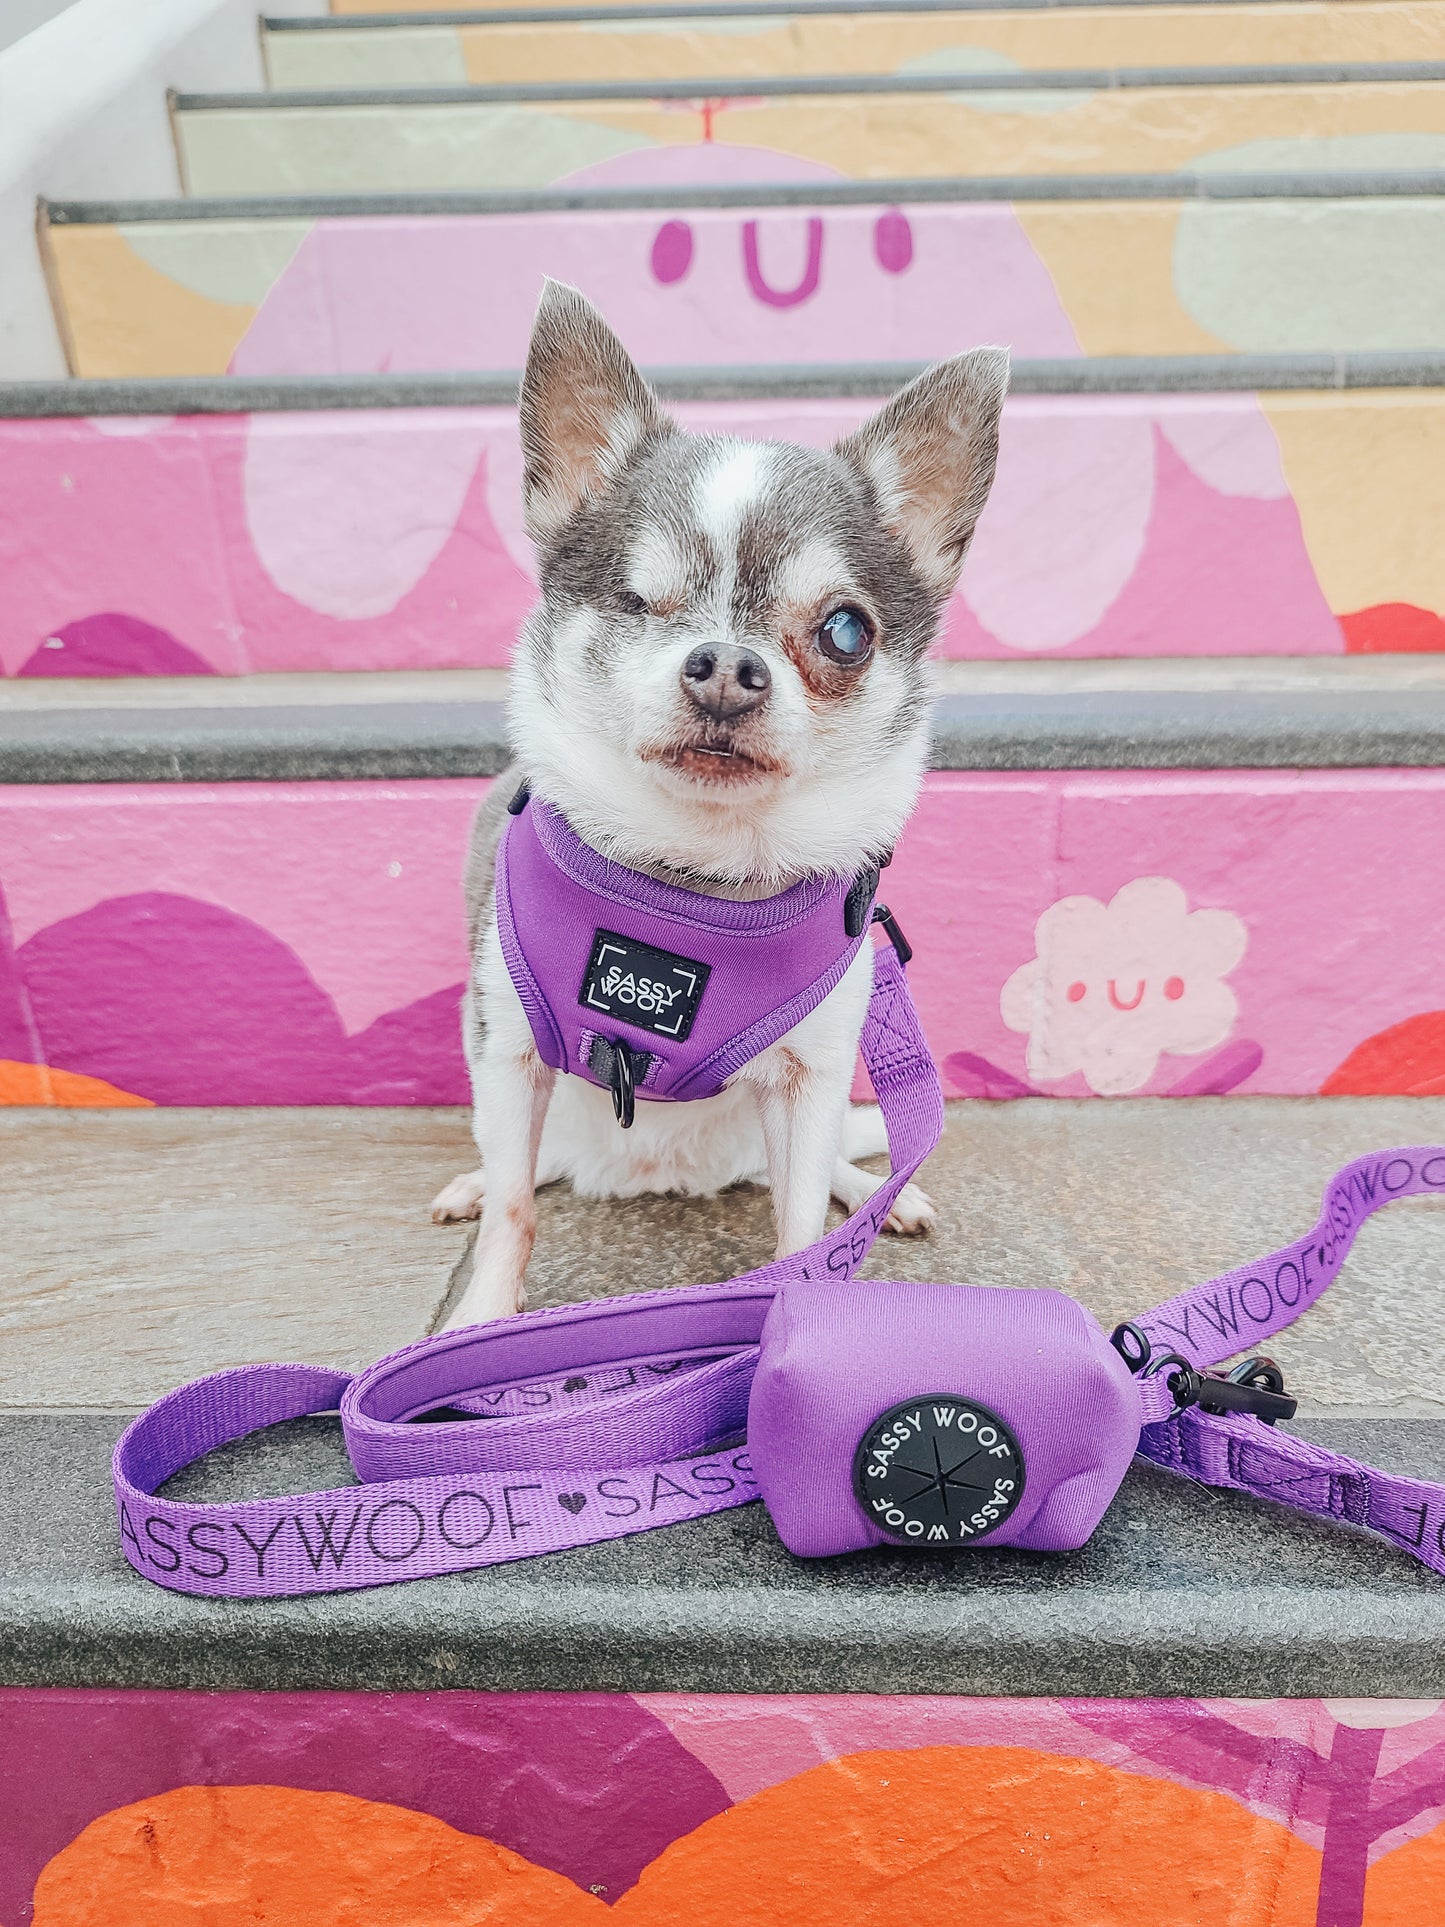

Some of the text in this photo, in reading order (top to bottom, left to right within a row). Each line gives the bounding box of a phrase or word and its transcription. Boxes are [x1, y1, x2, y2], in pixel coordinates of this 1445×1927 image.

[600, 975, 674, 1015] WOOF
[608, 965, 683, 1003] SASSY
[867, 1406, 1011, 1479] SASSY WOOF
[871, 1477, 1015, 1541] SASSY WOOF
